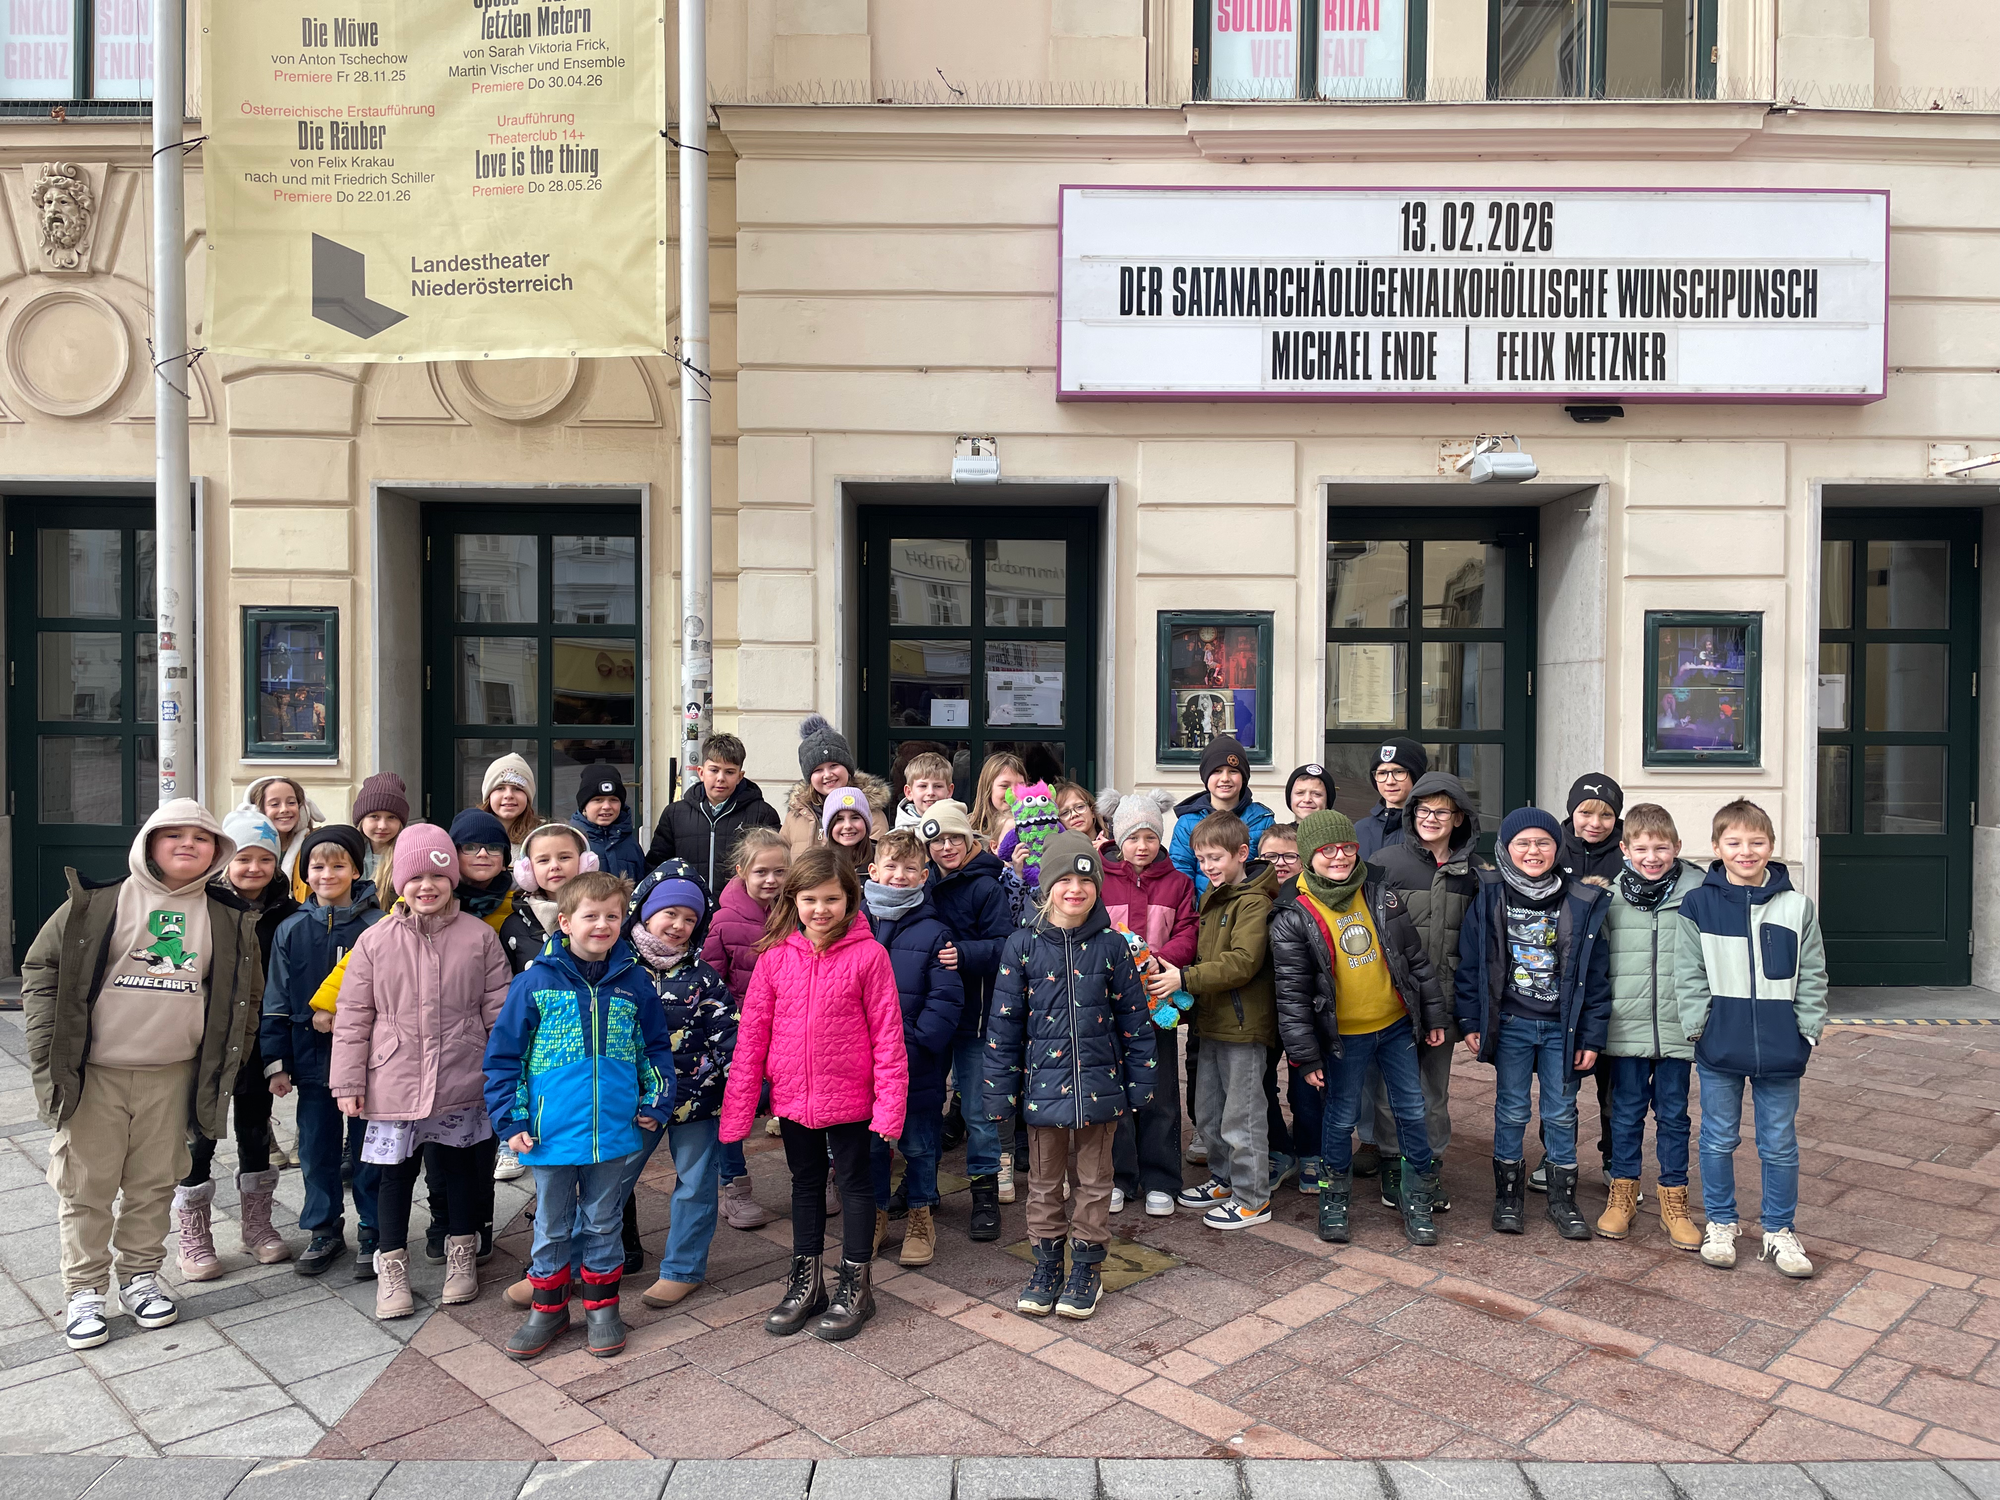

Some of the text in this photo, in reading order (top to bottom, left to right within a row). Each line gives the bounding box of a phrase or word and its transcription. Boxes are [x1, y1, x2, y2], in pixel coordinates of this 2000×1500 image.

[9, 0, 148, 35] INKLU SION
[481, 9, 531, 40] letzten
[537, 5, 591, 37] Metern
[1217, 0, 1292, 32] SOLIDA
[301, 17, 379, 47] Die Möwe
[271, 53, 408, 66] von Anton Tschechow
[463, 38, 610, 59] von Sarah Viktoria Frick,
[1250, 38, 1367, 78] VIEL FALT
[4, 42, 68, 80] GRENZ
[449, 55, 626, 78] Martin Vischer und Ensemble
[274, 70, 406, 83] Premiere Fr 28.11.25
[472, 74, 603, 94] Premiere Do 30.04.26
[240, 100, 436, 118] Österreichische Erstaufführung
[497, 112, 575, 127] Uraufführung
[298, 120, 387, 151] Die Räuber
[488, 129, 585, 145] Theaterclub 14+
[290, 156, 395, 168] von Felix Krakau
[475, 143, 599, 179] Love is the thing
[244, 172, 436, 185] nach und mit Friedrich Schiller
[472, 179, 603, 197] Premiere Do 28.05.26
[273, 189, 411, 203] Premiere Do 22.01.26
[1401, 201, 1554, 253] 13.02.2026
[411, 251, 550, 273] Landestheater
[411, 273, 573, 297] Niederösterreich
[1119, 260, 1819, 319] DER SATANARCHÄOLÜGENIALKOHÖLLISCHE WUNSCHPUNSCH
[1271, 331, 1437, 381] MICHAEL ENDE
[1496, 331, 1667, 381] FELIX METZNER
[113, 974, 199, 993] MINECRAFT
